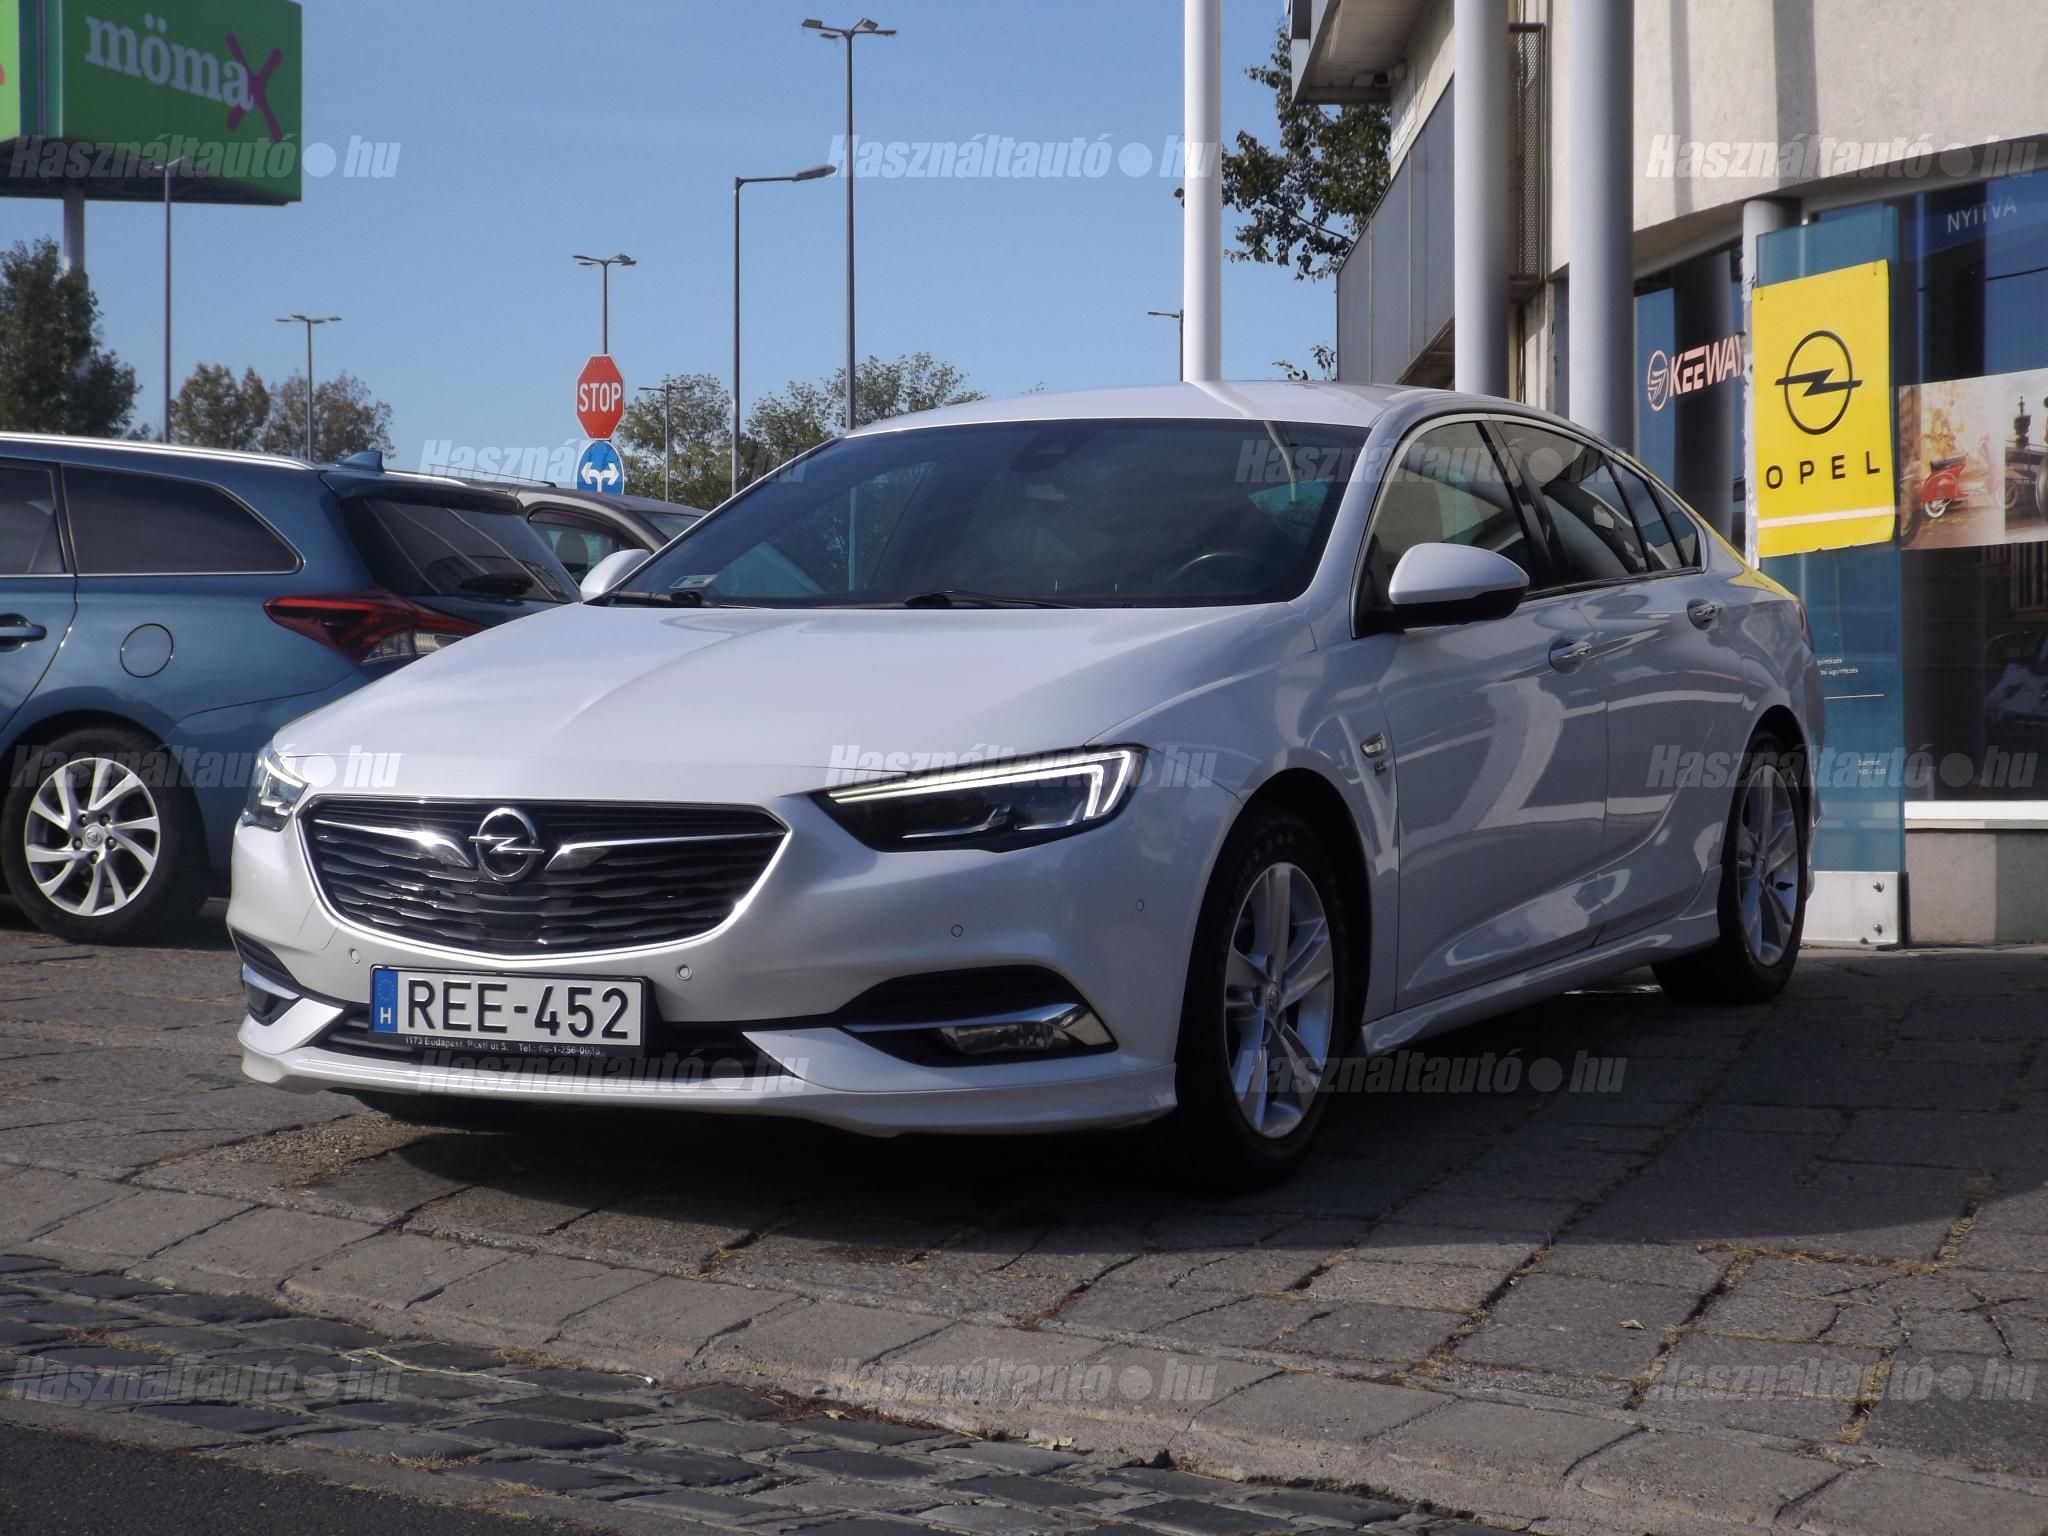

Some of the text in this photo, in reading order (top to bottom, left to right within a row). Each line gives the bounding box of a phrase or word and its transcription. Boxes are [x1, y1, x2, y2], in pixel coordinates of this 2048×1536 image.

[1947, 195, 2017, 233] NYITVA
[1669, 335, 1744, 398] KEEWAY
[579, 382, 622, 412] STOP
[1766, 451, 1881, 489] OPEL
[380, 1007, 392, 1025] H
[408, 978, 629, 1040] REE-452
